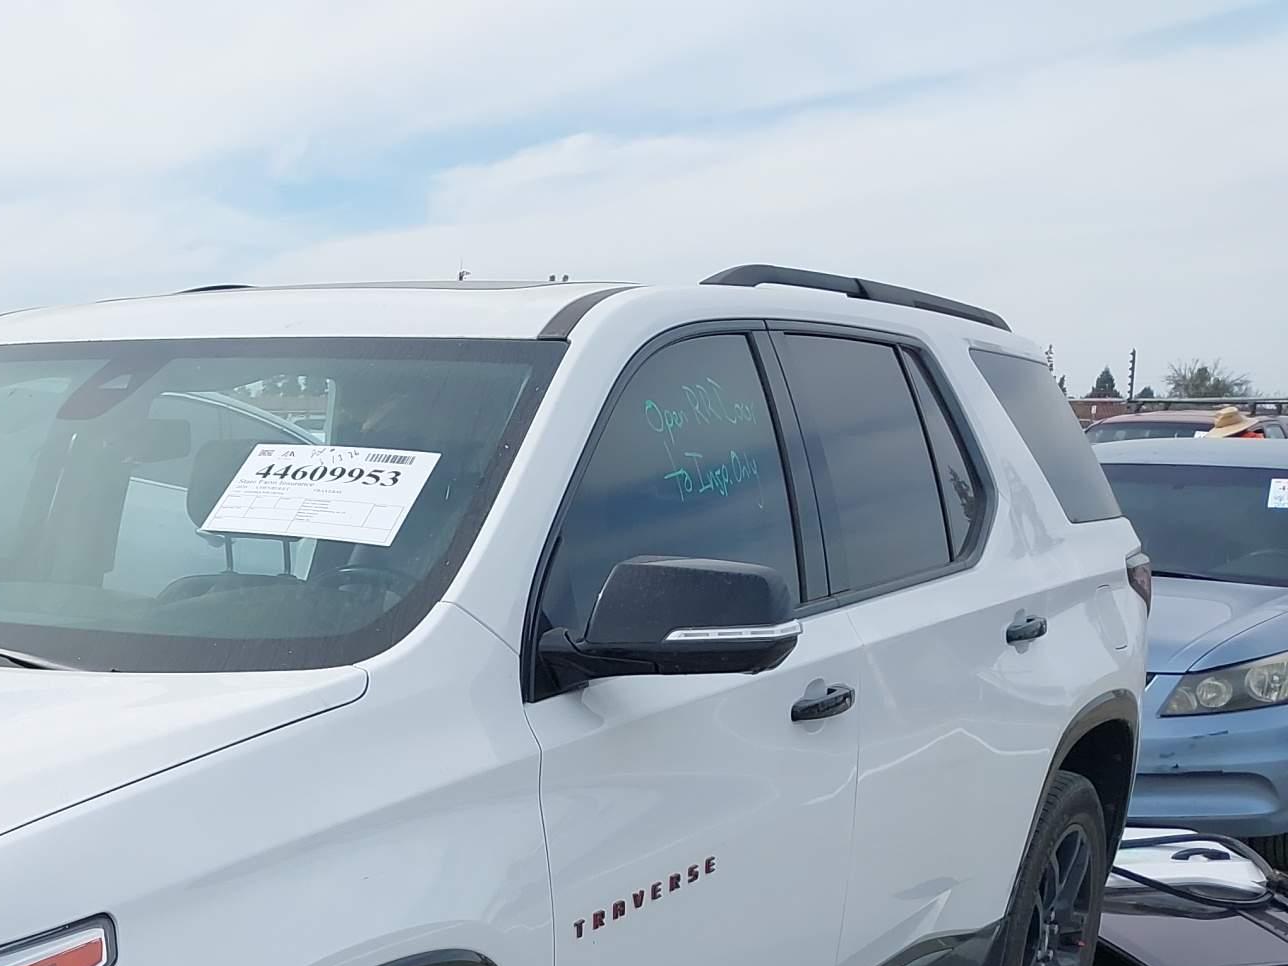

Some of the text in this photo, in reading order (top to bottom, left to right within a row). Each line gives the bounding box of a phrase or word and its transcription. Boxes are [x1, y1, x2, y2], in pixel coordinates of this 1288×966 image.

[255, 463, 403, 487] 44609953
[663, 440, 693, 502] To
[573, 855, 717, 939] TRAVERSE
